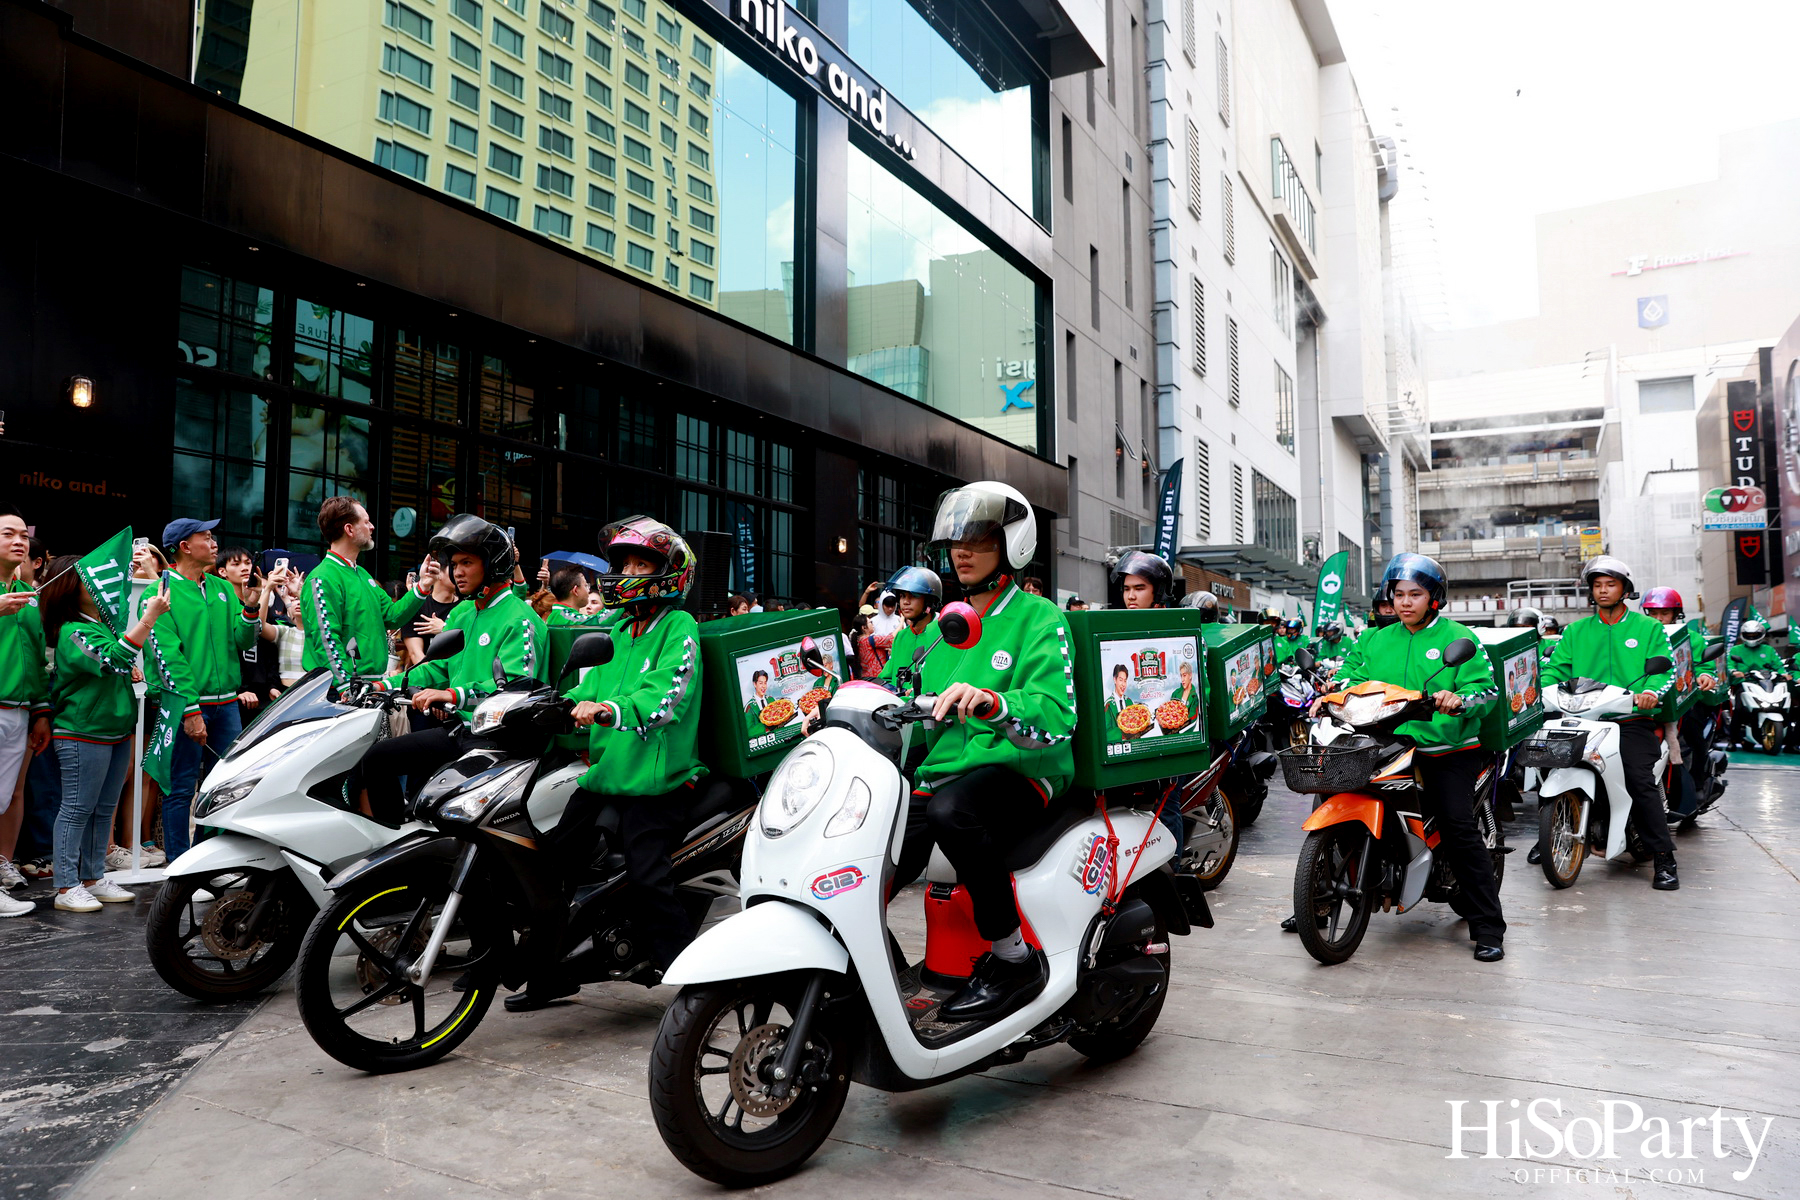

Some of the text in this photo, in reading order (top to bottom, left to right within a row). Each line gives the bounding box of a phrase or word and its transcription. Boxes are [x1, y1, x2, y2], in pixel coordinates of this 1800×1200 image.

[740, 0, 819, 75] niko
[828, 63, 887, 135] and
[1736, 437, 1755, 487] TUD
[19, 471, 62, 490] niko
[68, 480, 106, 495] and
[1165, 489, 1174, 512] THE
[1727, 620, 1740, 642] PIZZA
[993, 655, 1008, 664] PIZZA
[493, 811, 520, 824] HONDA
